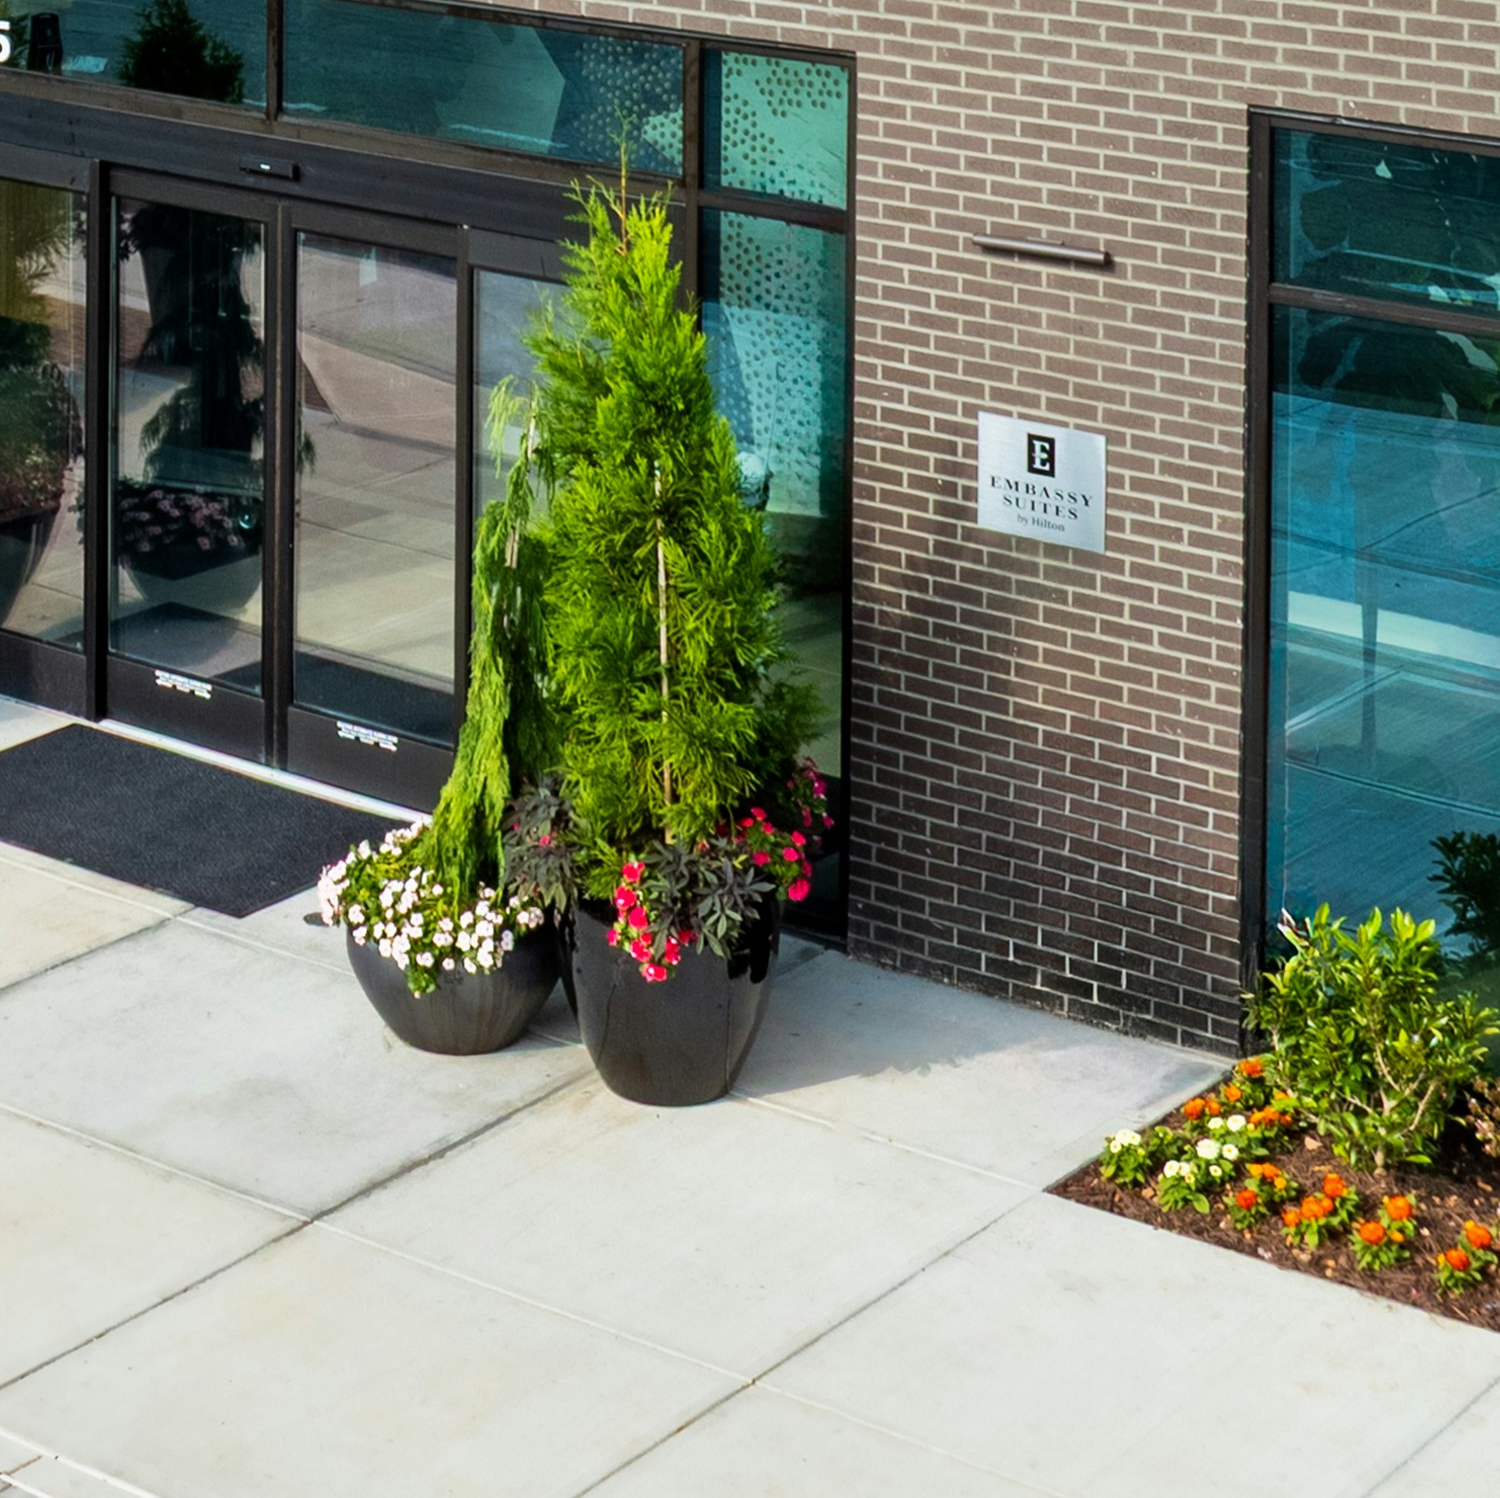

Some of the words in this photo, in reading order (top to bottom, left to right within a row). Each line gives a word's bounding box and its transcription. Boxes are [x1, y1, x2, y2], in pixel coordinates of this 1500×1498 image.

[1031, 439, 1051, 472] E
[990, 475, 1093, 508] EMBASSY
[1002, 494, 1079, 521] SUITES
[1017, 514, 1028, 525] by
[1031, 515, 1066, 532] Hilton
